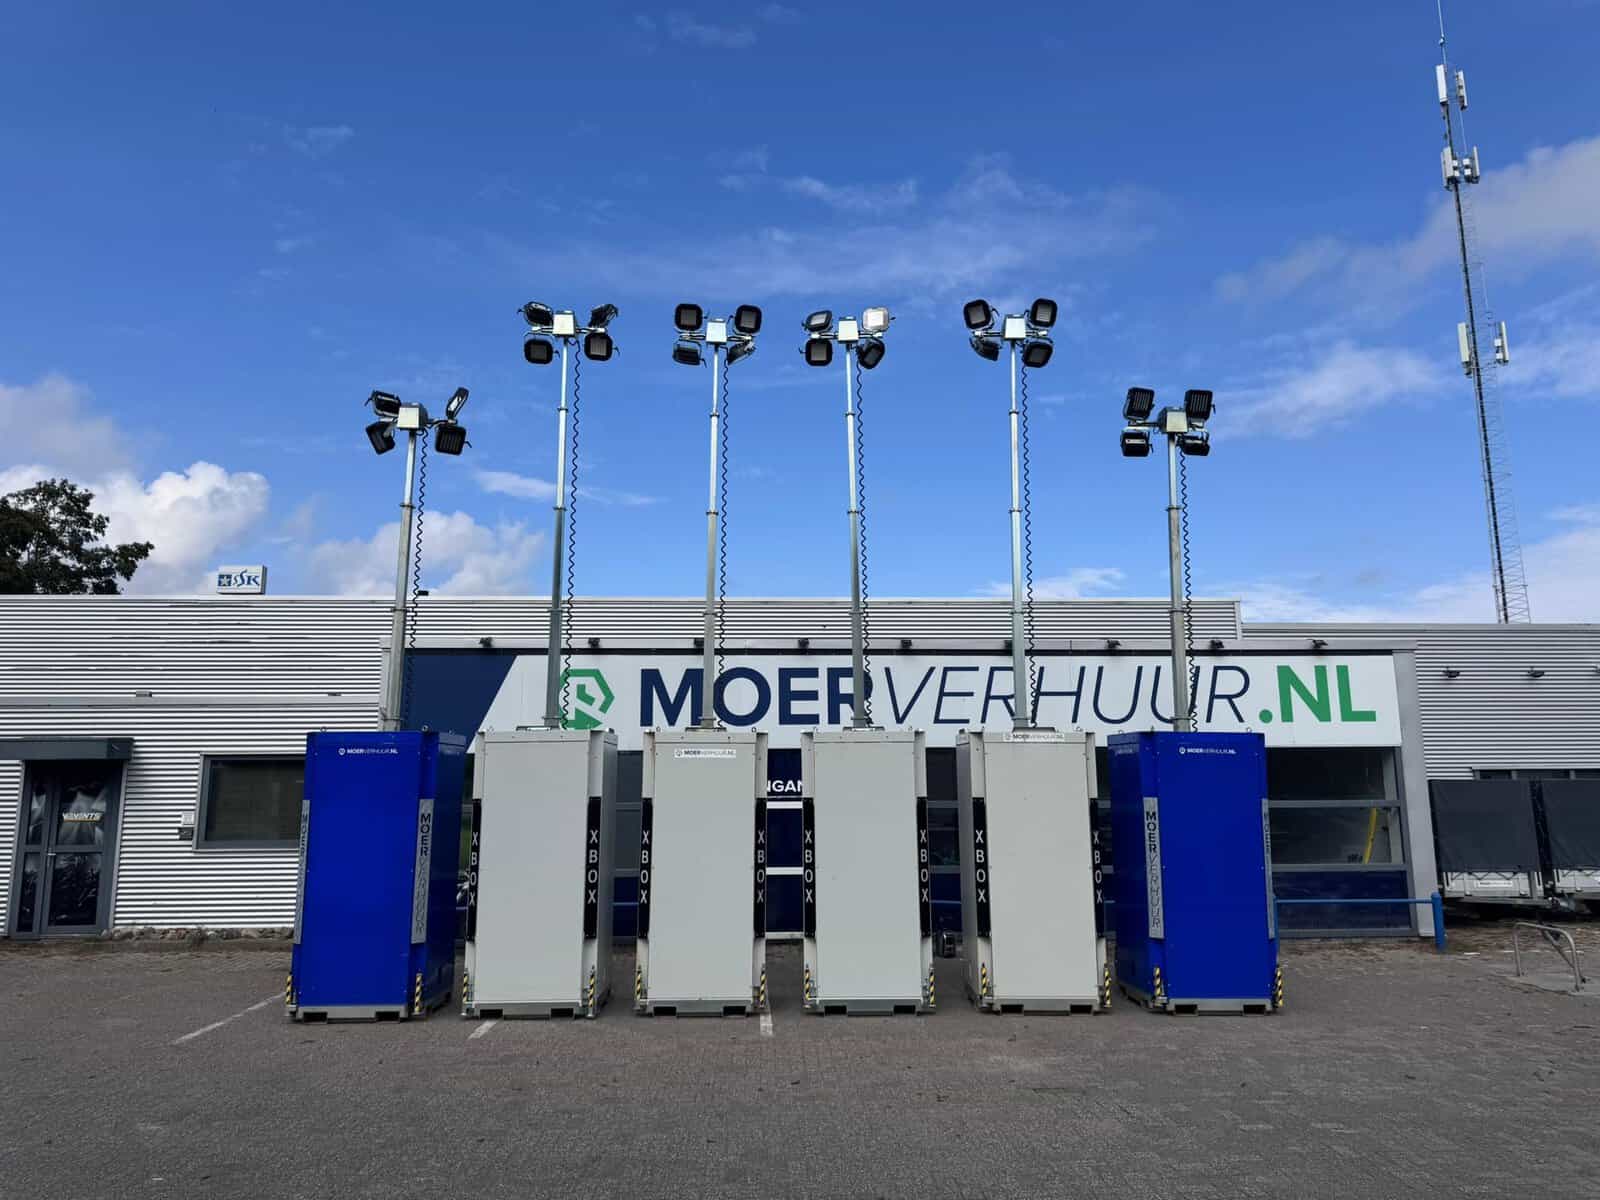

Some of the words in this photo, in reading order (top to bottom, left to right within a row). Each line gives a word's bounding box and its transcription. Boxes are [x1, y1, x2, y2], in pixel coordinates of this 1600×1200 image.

[640, 665, 1377, 724] MOERVERHUUR.NL
[468, 830, 479, 906] XBOX
[586, 829, 598, 905] XBOX
[640, 830, 650, 904] XBOX
[756, 830, 766, 903] XBOX
[805, 830, 814, 903] XBOX
[920, 829, 929, 903] XBOX
[975, 830, 987, 902] XBOX
[1092, 830, 1103, 904] XBOX
